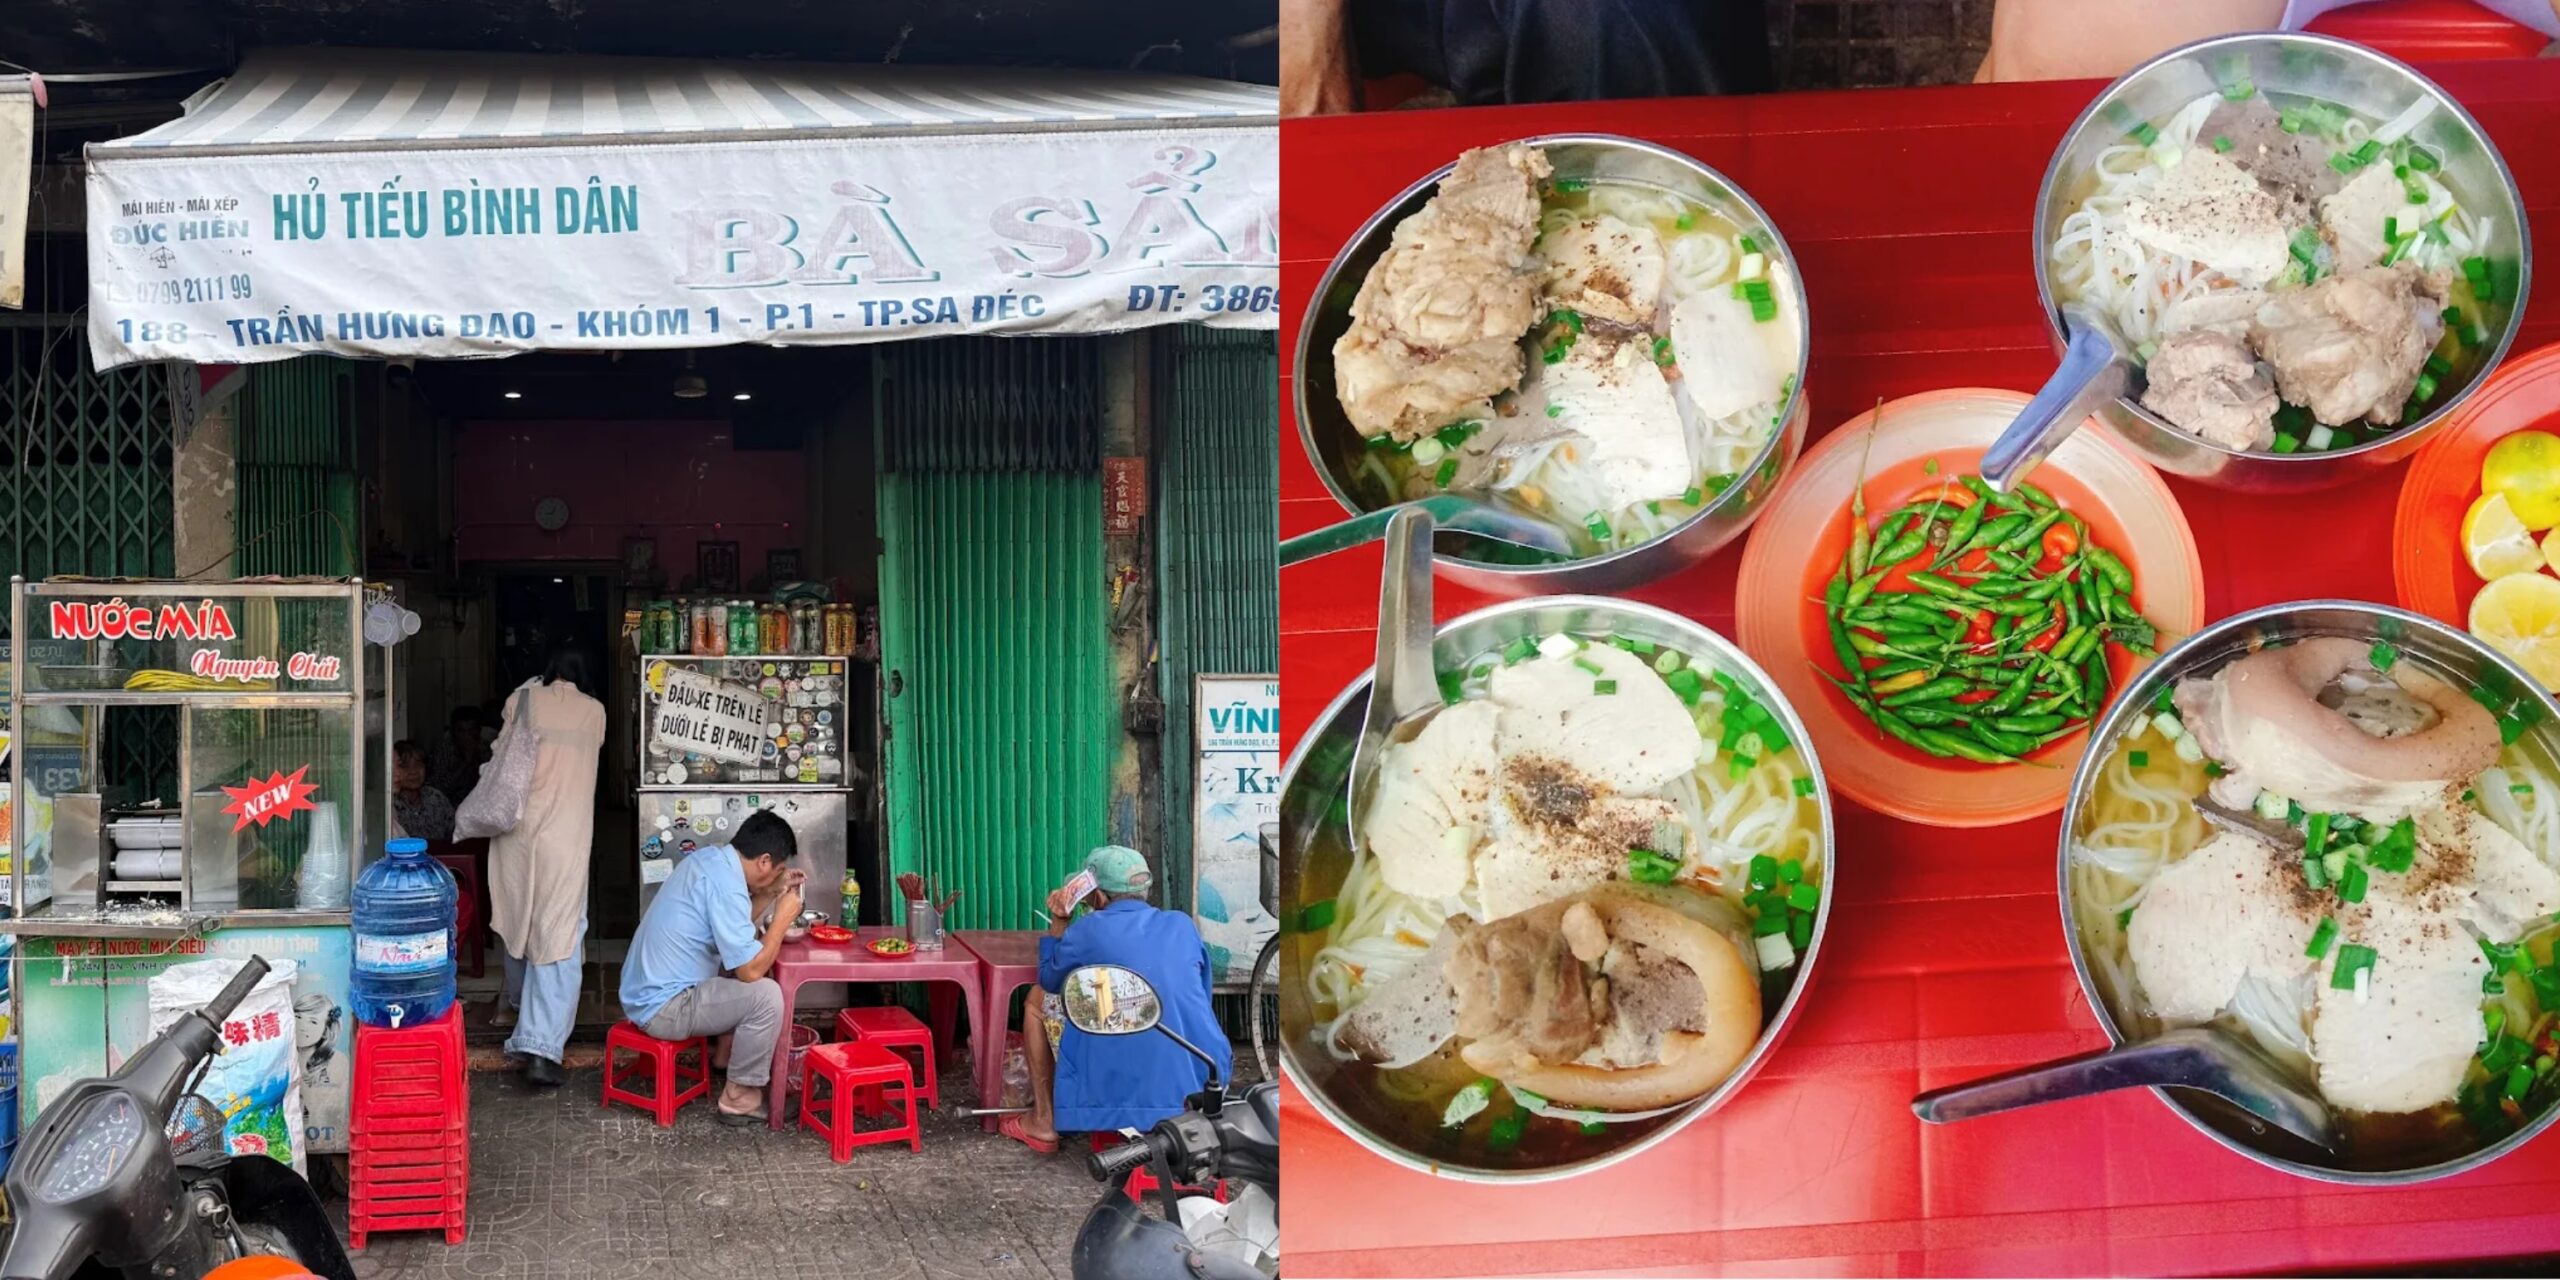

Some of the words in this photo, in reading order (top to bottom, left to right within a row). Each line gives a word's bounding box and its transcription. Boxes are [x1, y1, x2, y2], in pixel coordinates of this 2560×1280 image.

[122, 200, 142, 217] MÁI
[146, 199, 175, 214] HIÊN
[187, 196, 210, 212] MÁI
[213, 194, 239, 211] XẾP
[272, 176, 326, 241] HỦ
[340, 174, 428, 239] TIẾU
[443, 178, 541, 237] BÌNH
[555, 175, 639, 235] DÂN
[110, 219, 167, 245] ĐỨC
[672, 178, 941, 290] BÀ
[116, 318, 188, 344] 188
[226, 305, 325, 347] TRẦN
[338, 310, 444, 341] HƯNG
[458, 311, 536, 344] ĐẠO
[577, 304, 689, 338] KHÓM
[704, 306, 720, 333] 1
[766, 303, 814, 331] P.1
[858, 296, 959, 327] TP.SA
[971, 287, 1046, 323] ĐÉC
[1126, 284, 1186, 312] ĐT:
[51, 597, 153, 640] NƯỚC
[155, 599, 236, 641] MÍA
[191, 648, 281, 682] Nguyên
[287, 651, 341, 681] Chất
[668, 681, 694, 708] ĐẬU
[695, 690, 713, 711] XE
[714, 694, 746, 720] TRÊN
[661, 713, 691, 739] DƯỚI
[710, 725, 725, 750] BỊ
[726, 729, 759, 756] PHẠT
[243, 779, 294, 820] NEW
[224, 1011, 282, 1046] 味精
